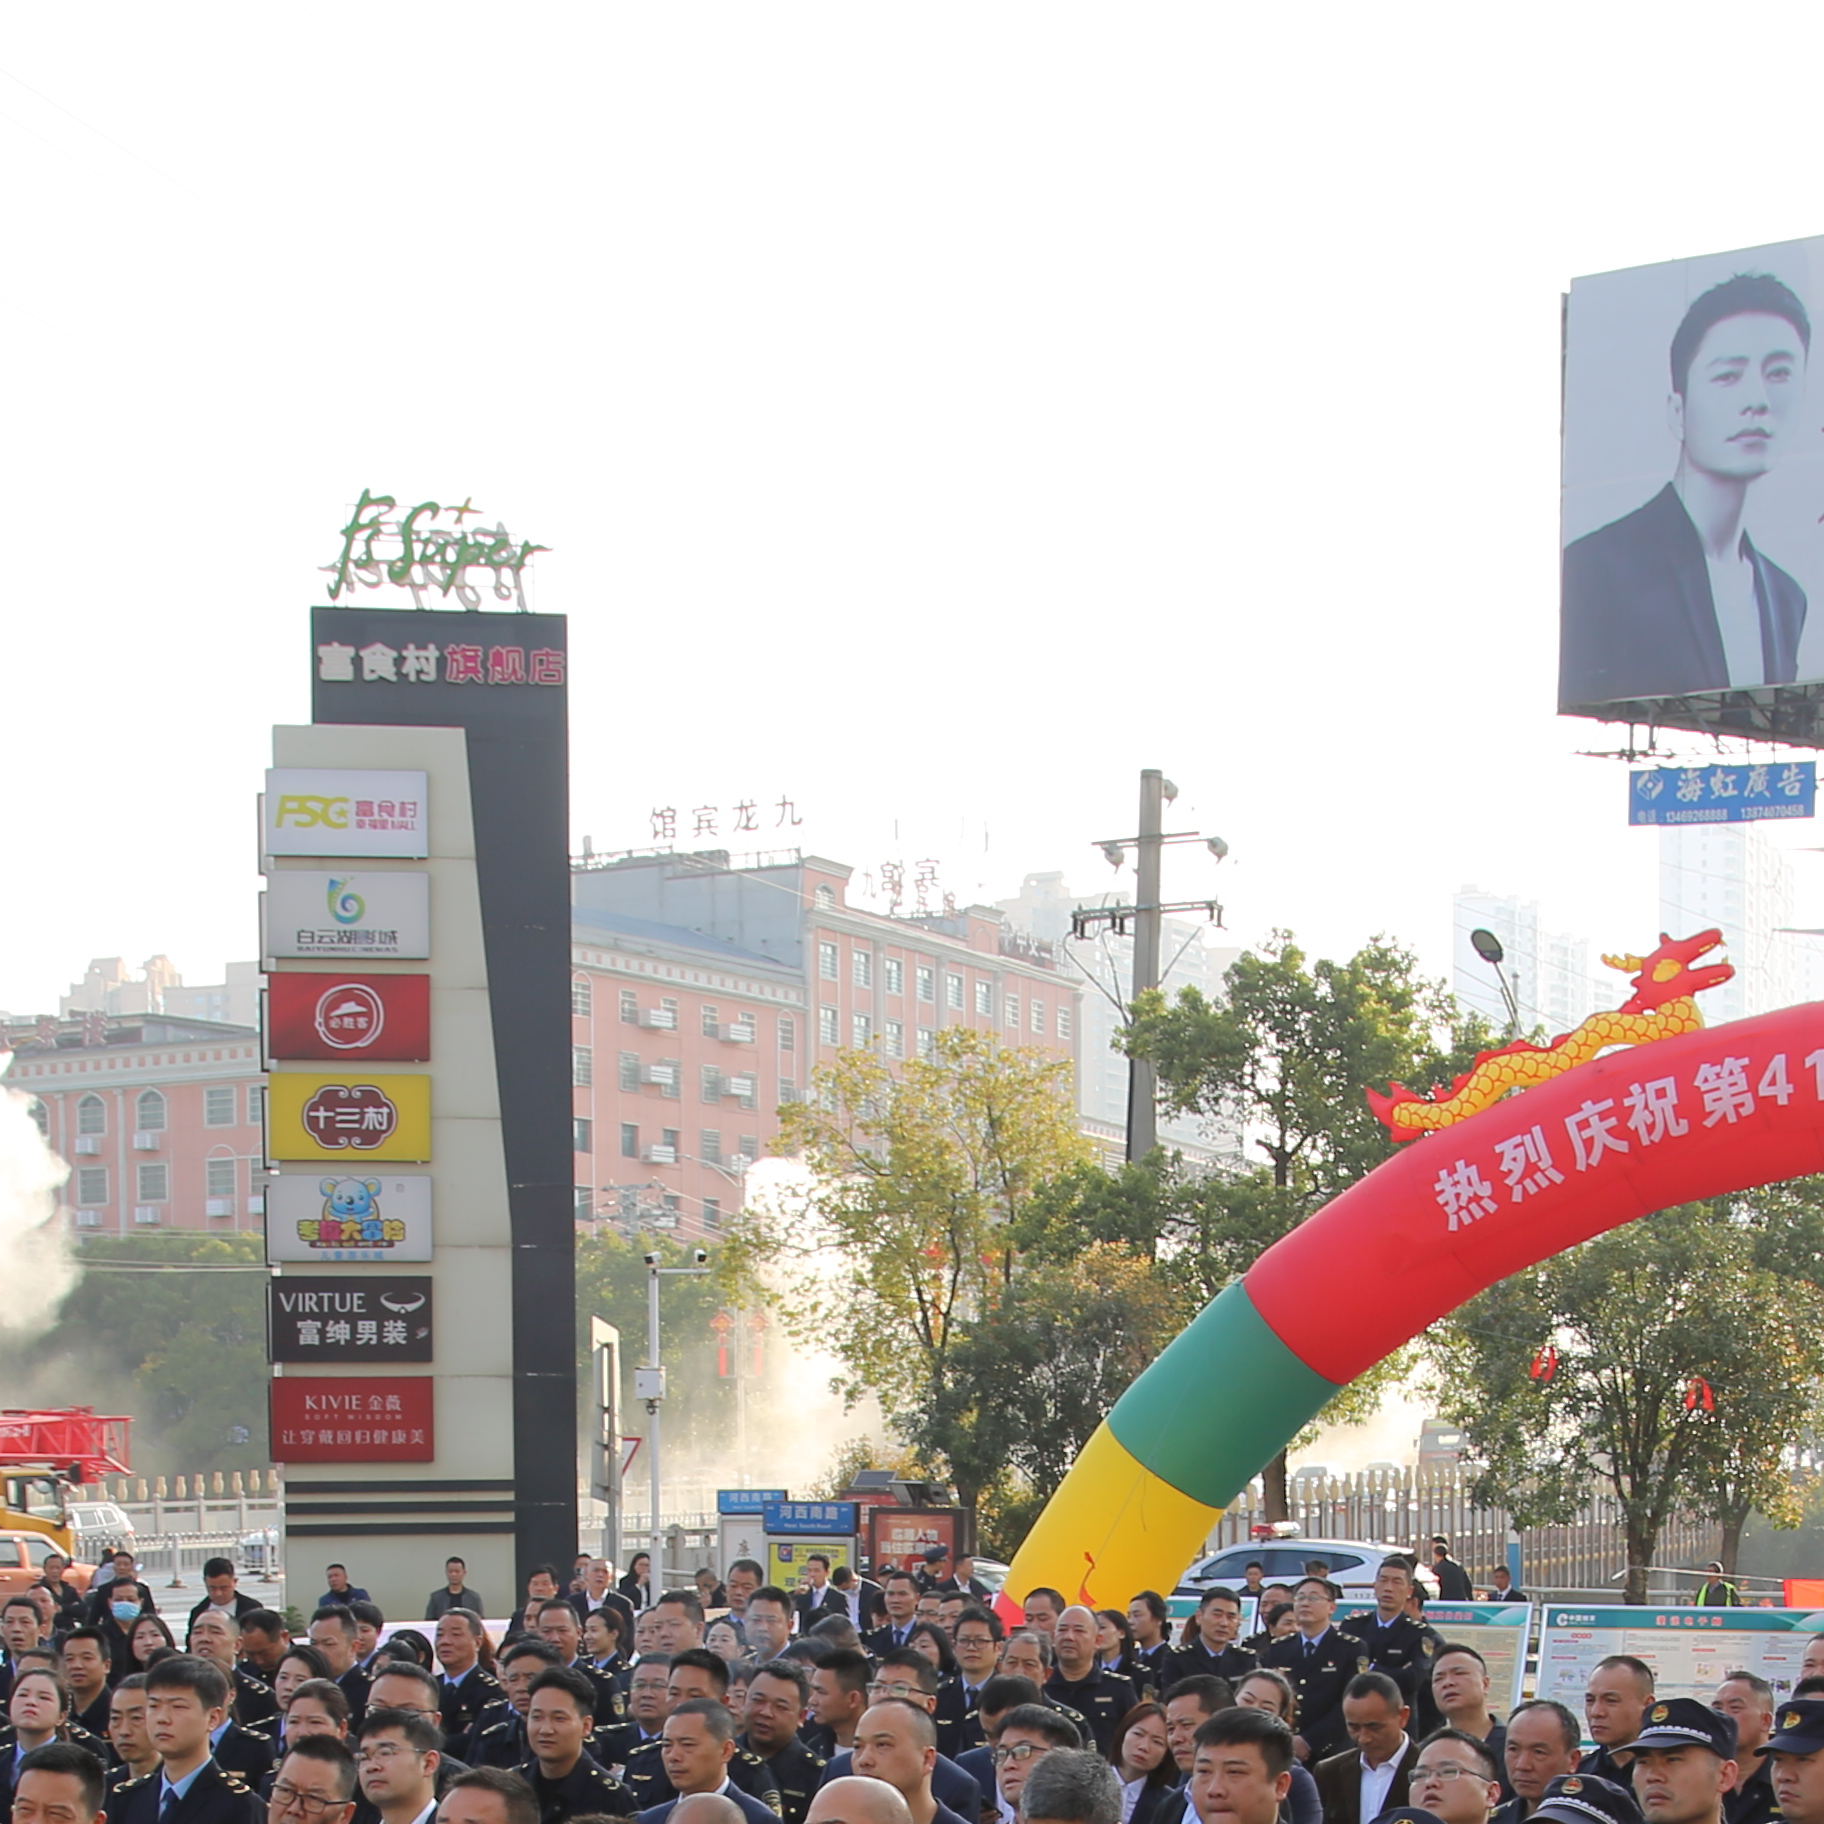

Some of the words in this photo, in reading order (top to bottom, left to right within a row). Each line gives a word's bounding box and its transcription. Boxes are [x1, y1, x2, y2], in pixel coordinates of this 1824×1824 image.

[317, 641, 565, 686] 富食村旗舰店
[1676, 764, 1806, 803] 海虹廣告
[355, 800, 418, 819] 富食村
[297, 929, 399, 946] 白云湖影城
[329, 1016, 369, 1029] 必胜客
[308, 1105, 391, 1131] 十三村
[278, 1292, 367, 1313] VIRTUE
[296, 1319, 409, 1346] 富绅男装
[304, 1395, 363, 1411] KIVIE
[367, 1395, 402, 1412] 金薇
[281, 1429, 425, 1446] 让穿戴回归健康美
[778, 1504, 840, 1521] 河西南路
